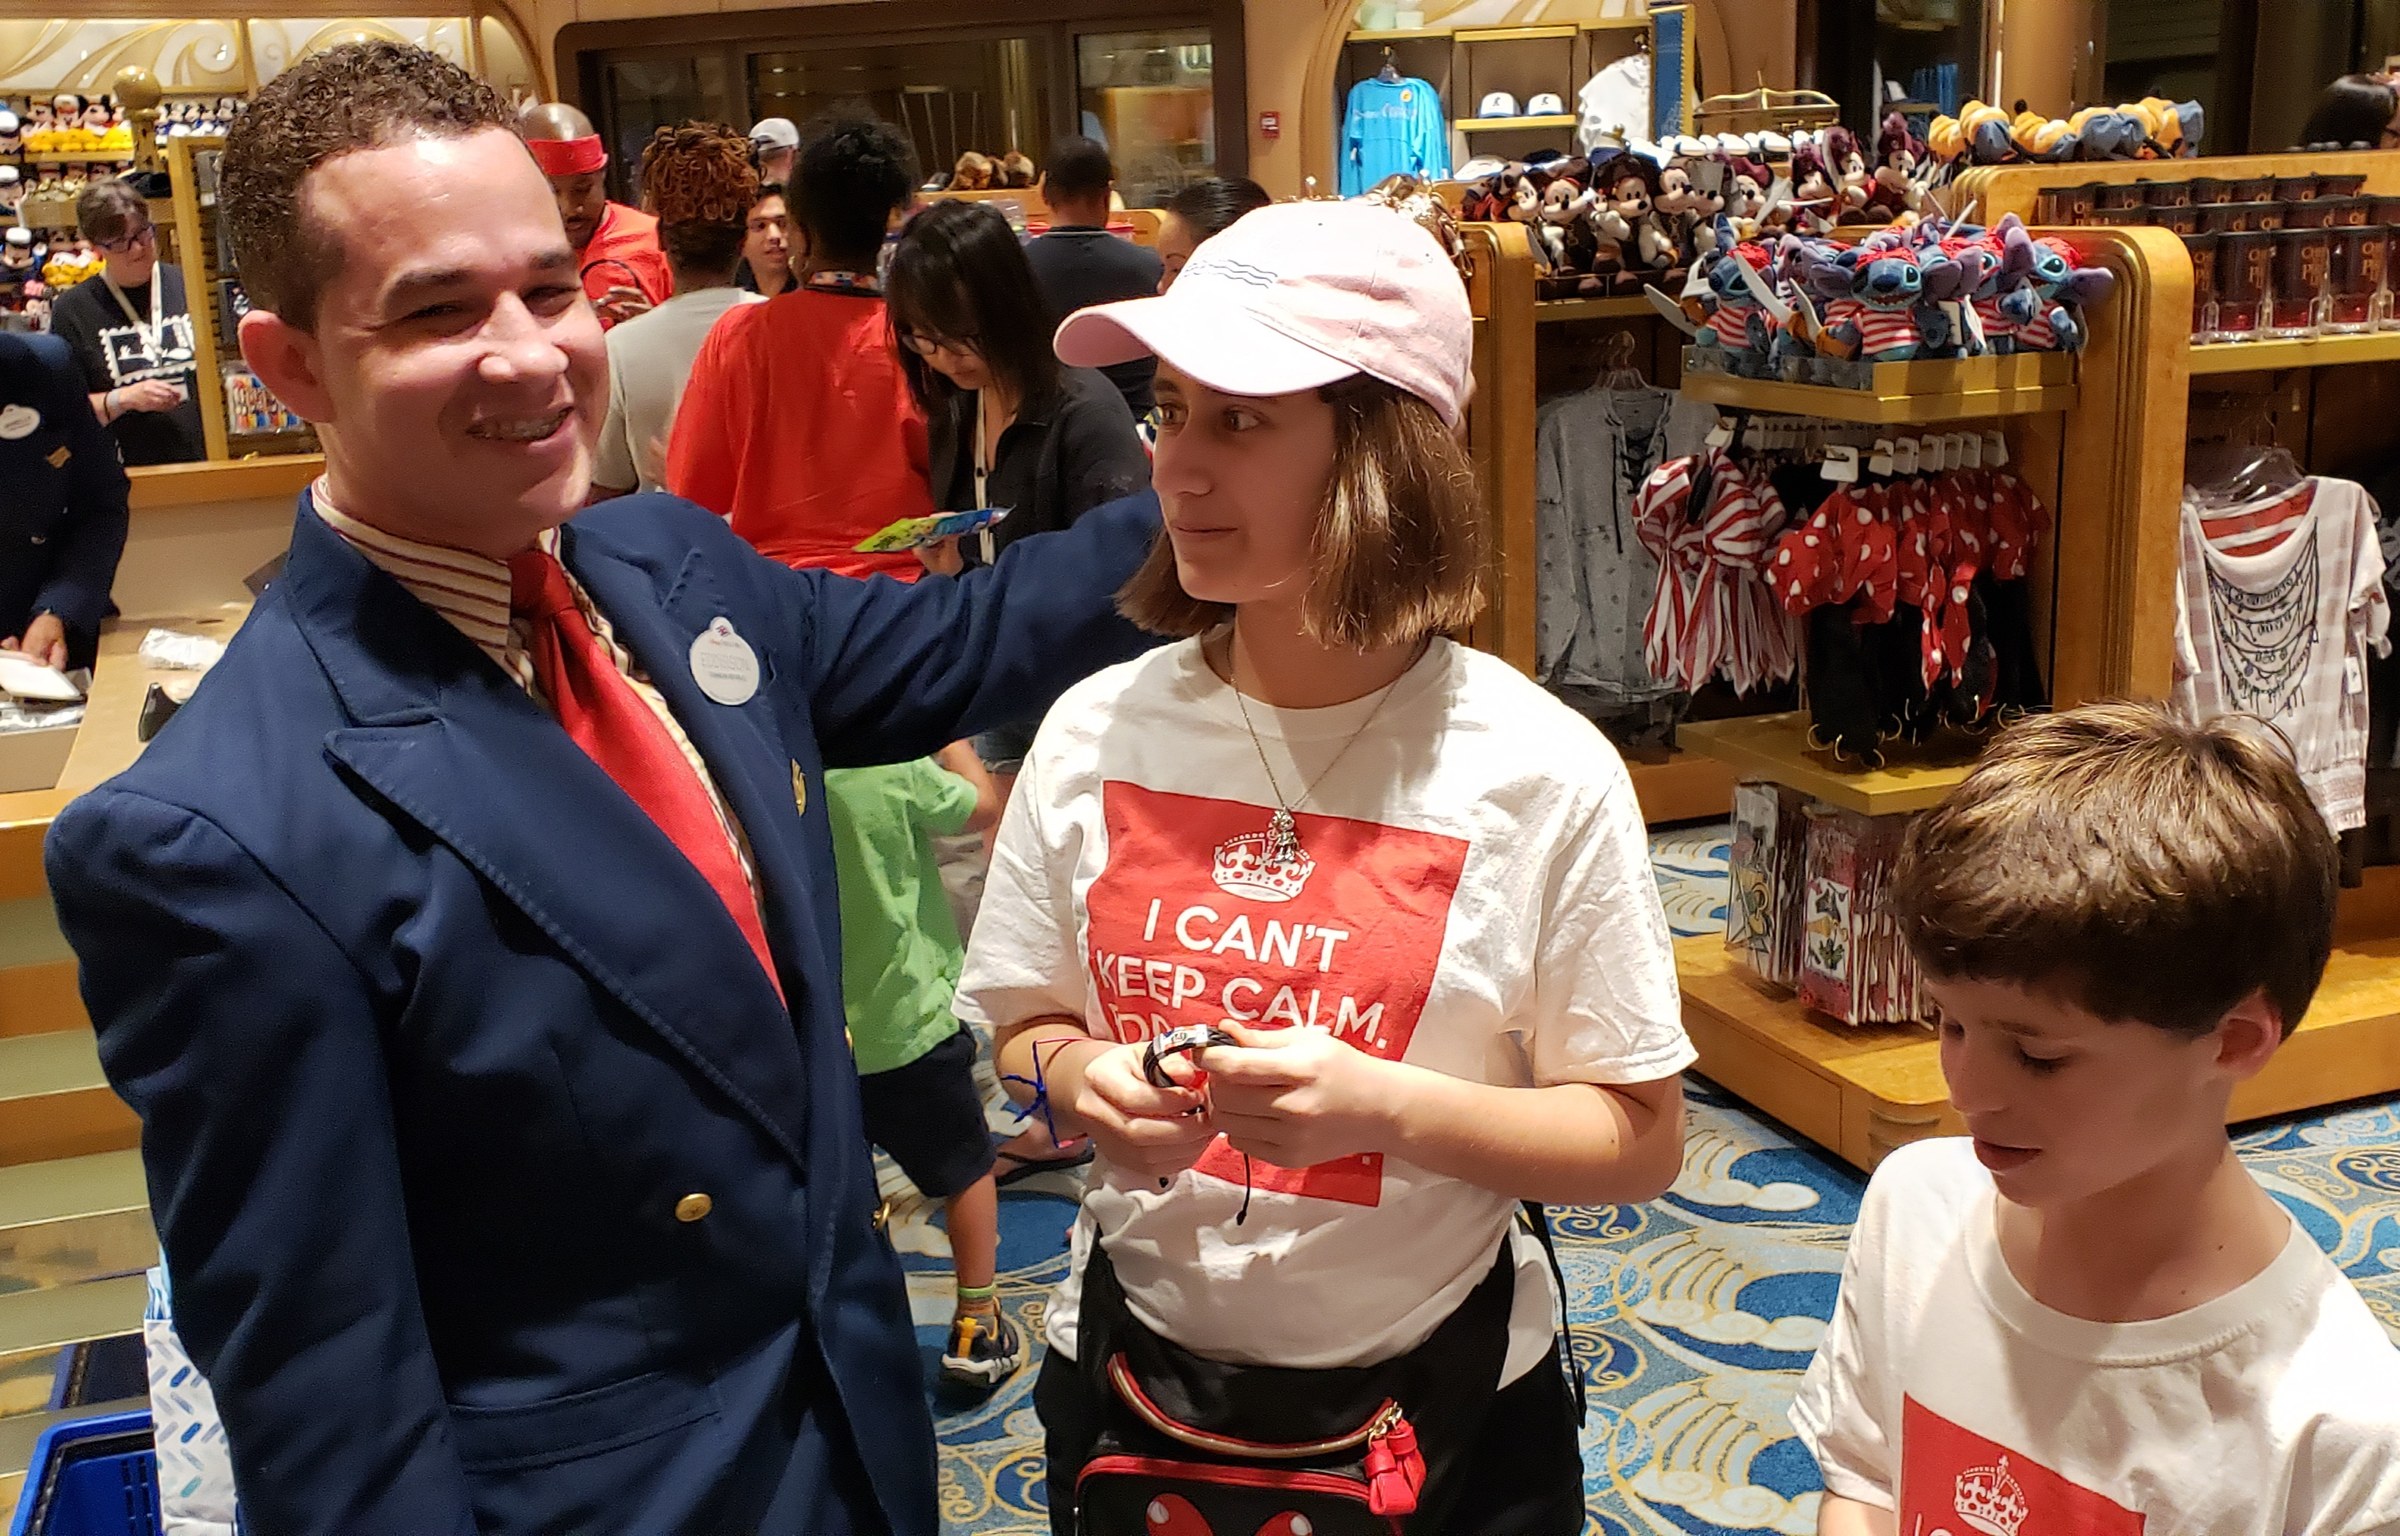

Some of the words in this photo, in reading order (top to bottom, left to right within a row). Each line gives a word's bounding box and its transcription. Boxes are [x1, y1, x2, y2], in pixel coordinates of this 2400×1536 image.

[1143, 898, 1161, 941] I
[1175, 905, 1349, 973] CAN'T
[1096, 950, 1206, 1009] KEEP
[1222, 978, 1387, 1050] CALM.
